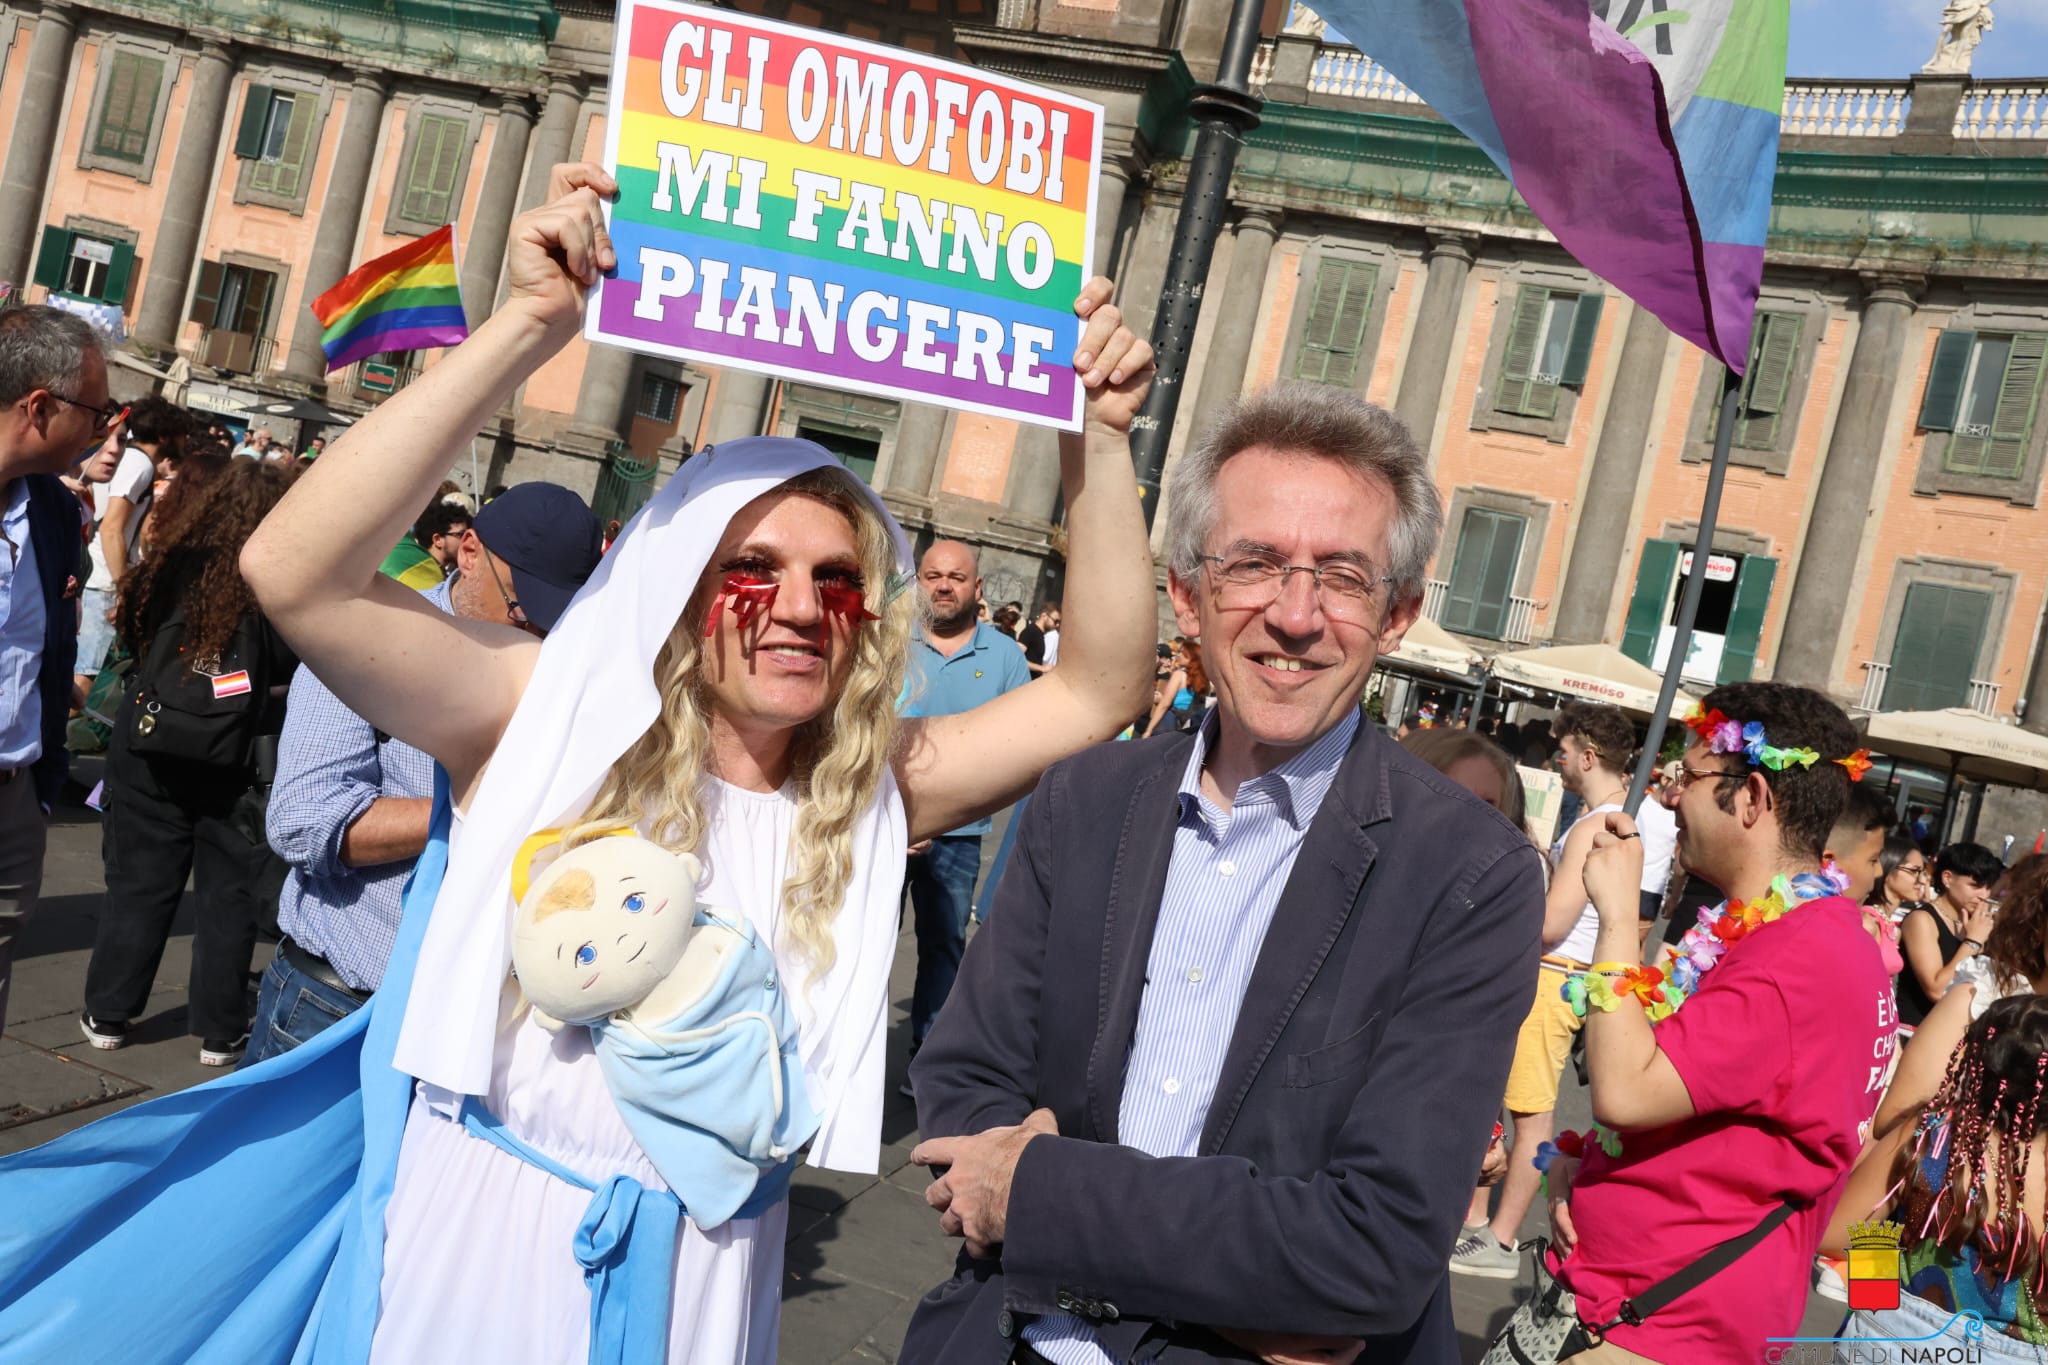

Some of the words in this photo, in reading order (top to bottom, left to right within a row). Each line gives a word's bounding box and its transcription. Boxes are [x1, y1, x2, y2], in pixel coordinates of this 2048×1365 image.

[660, 20, 770, 133] GLI
[786, 46, 1070, 203] OMOFOBI
[651, 140, 768, 231] MI
[787, 168, 1055, 290] FANNO
[633, 246, 1054, 396] PIANGERE
